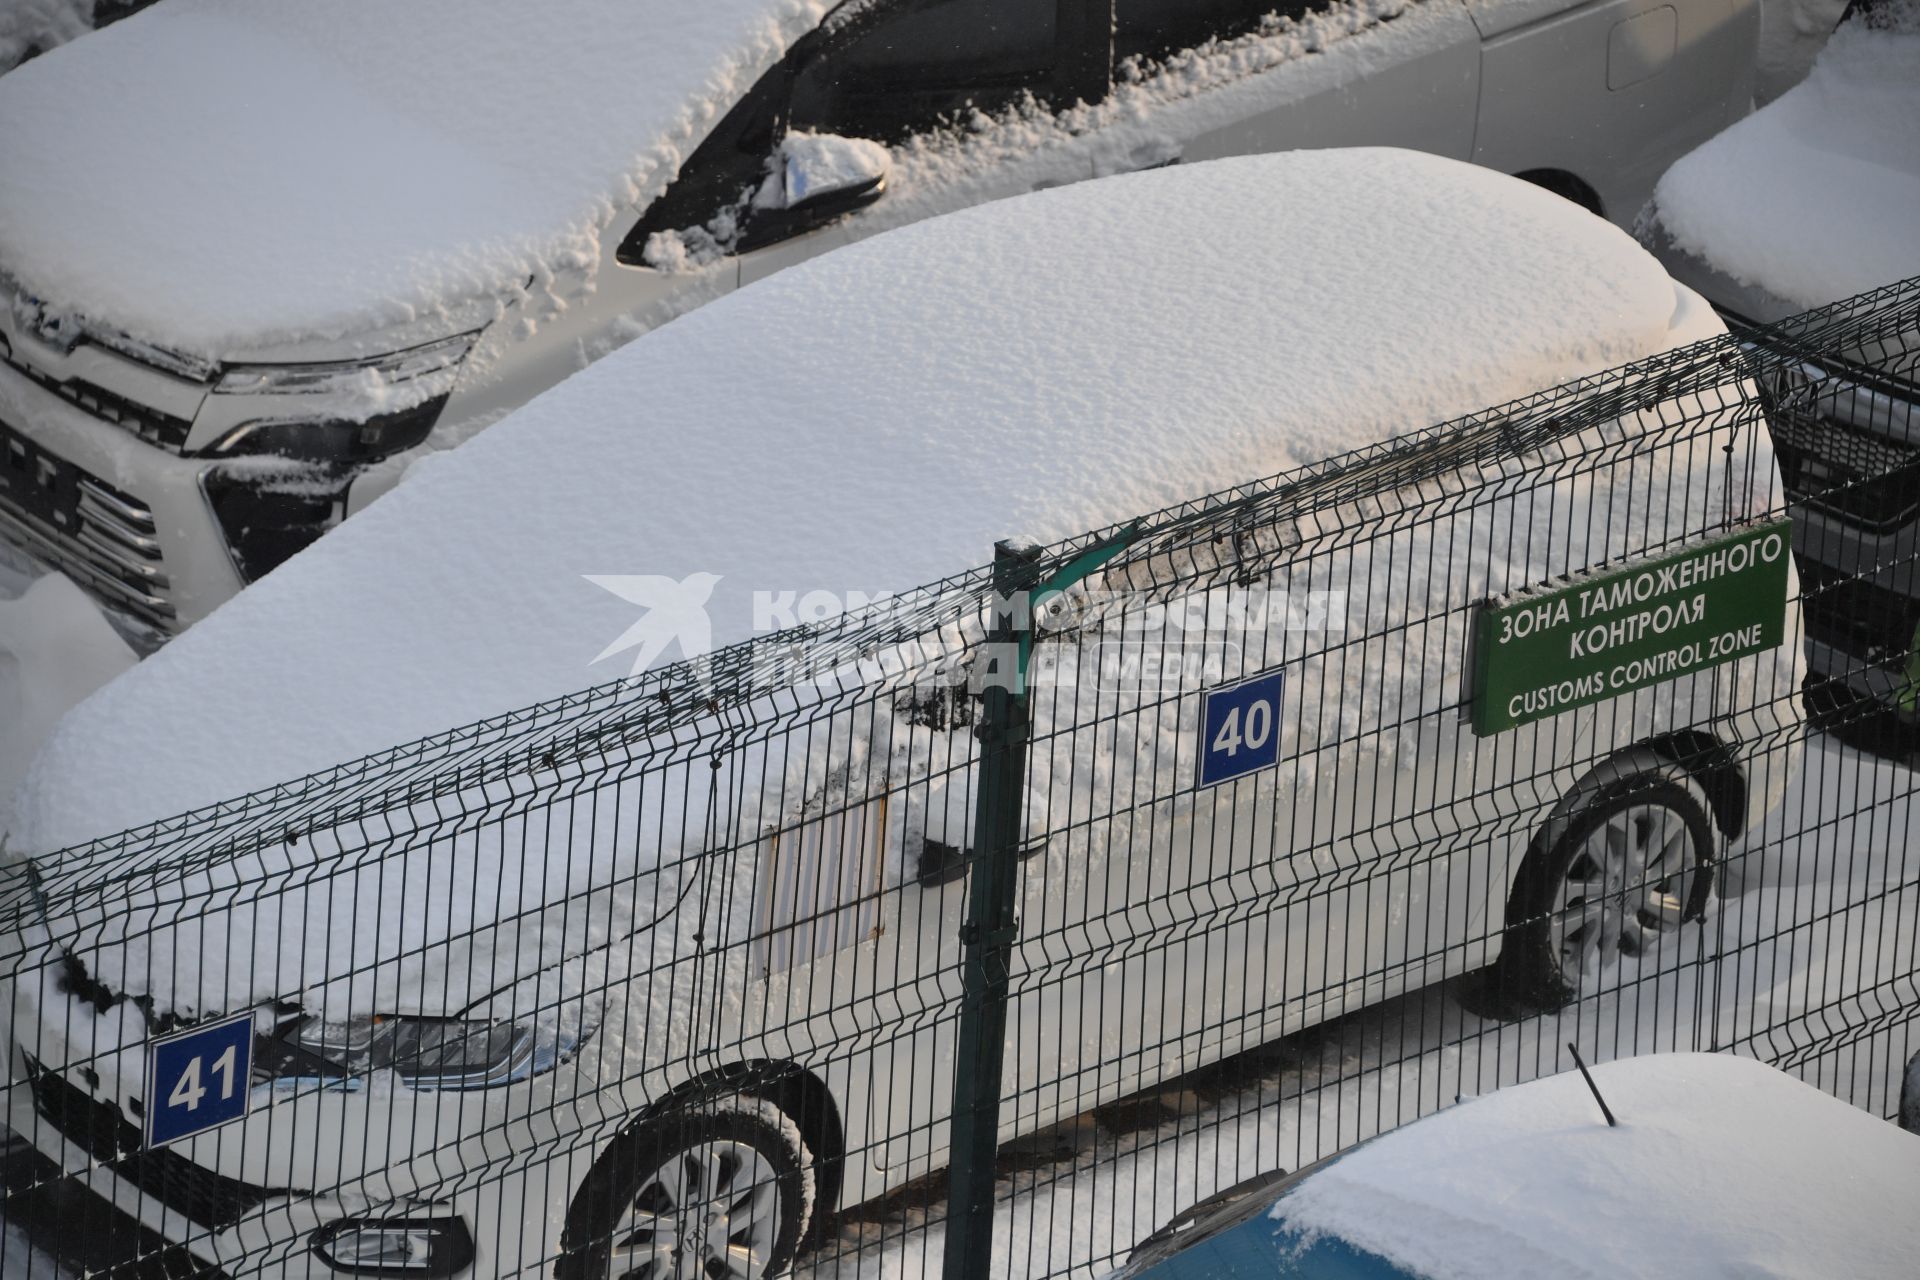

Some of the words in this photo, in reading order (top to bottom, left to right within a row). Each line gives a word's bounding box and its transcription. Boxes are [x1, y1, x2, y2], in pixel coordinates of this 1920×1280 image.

[1498, 598, 1571, 645] ЗОНА
[1579, 533, 1782, 619] ТАМОЖЕННОГО
[1570, 593, 1706, 660] КОНТРОЛЯ
[1508, 671, 1605, 718] CUSTOMS
[1609, 645, 1703, 690] CONTROL
[1708, 623, 1763, 659] ZONE
[1212, 699, 1272, 757] 40
[168, 1044, 237, 1112] 41
